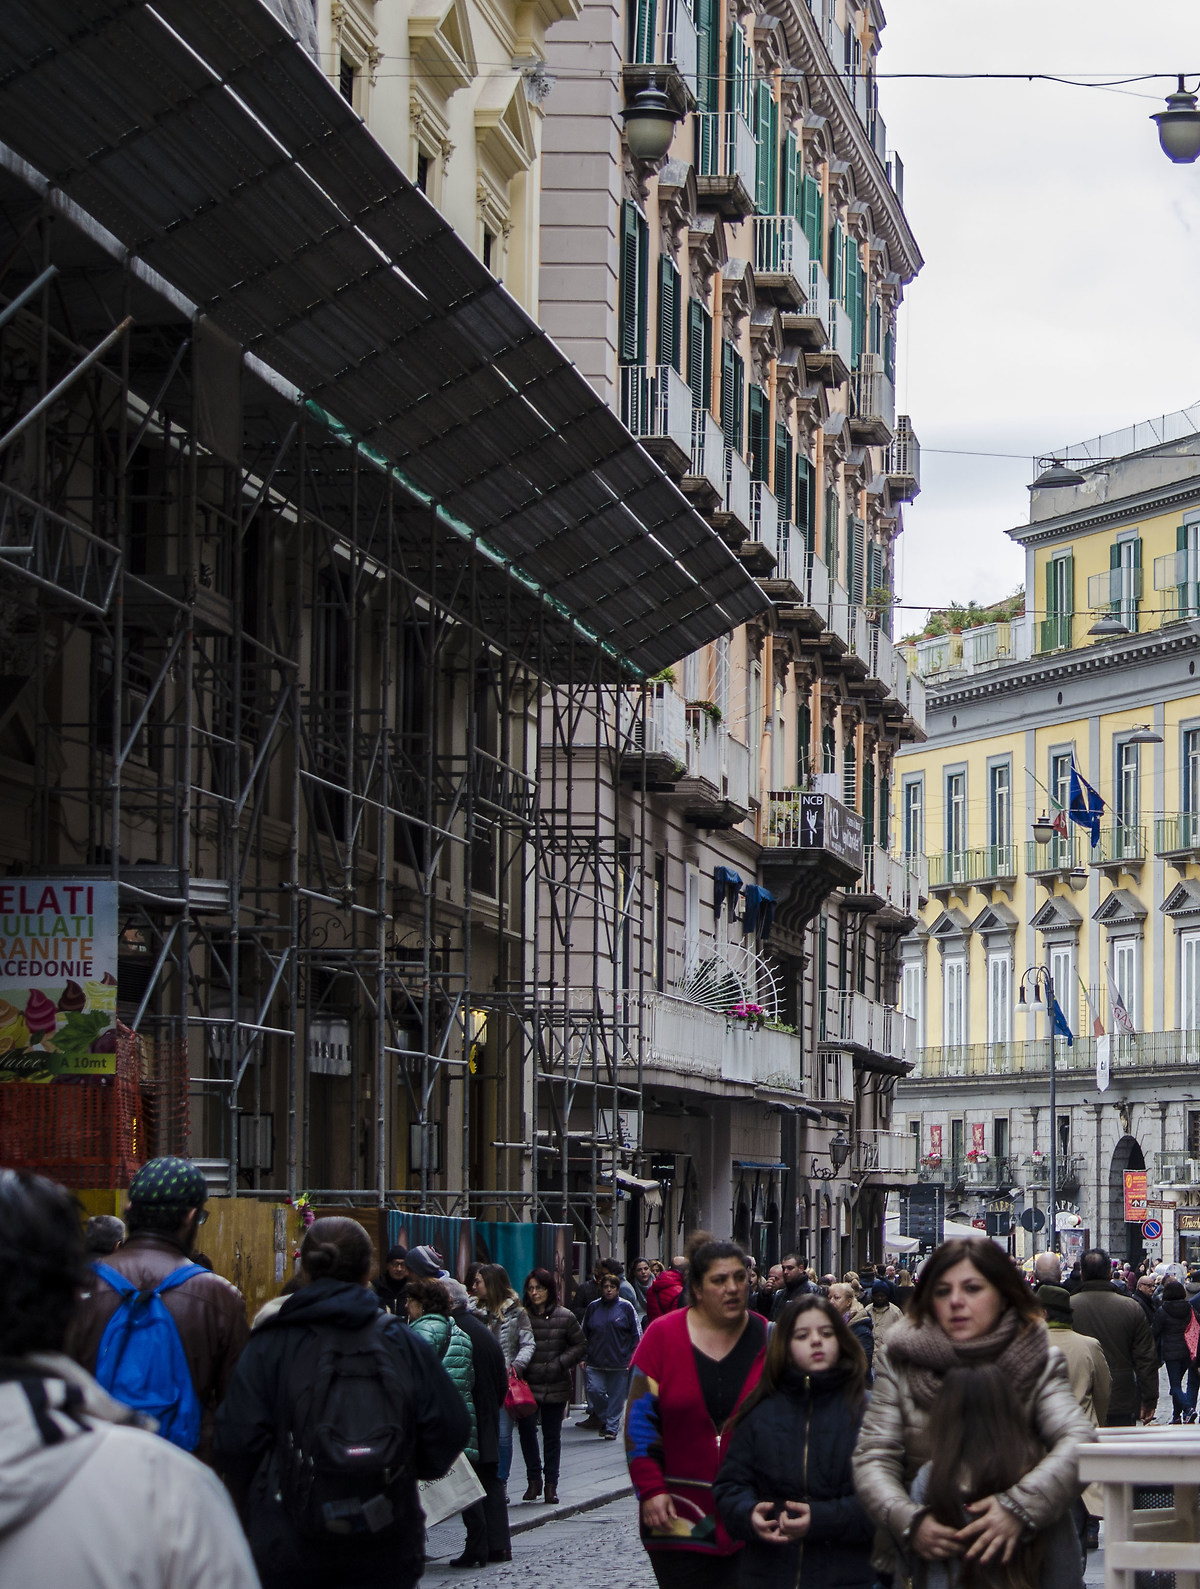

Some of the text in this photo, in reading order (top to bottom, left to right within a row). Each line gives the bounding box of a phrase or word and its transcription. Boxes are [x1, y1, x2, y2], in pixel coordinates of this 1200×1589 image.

[802, 795, 824, 806] NCB
[0, 885, 94, 915] ELATI
[3, 915, 94, 938] ULLATI
[60, 1056, 107, 1069] A 10mt
